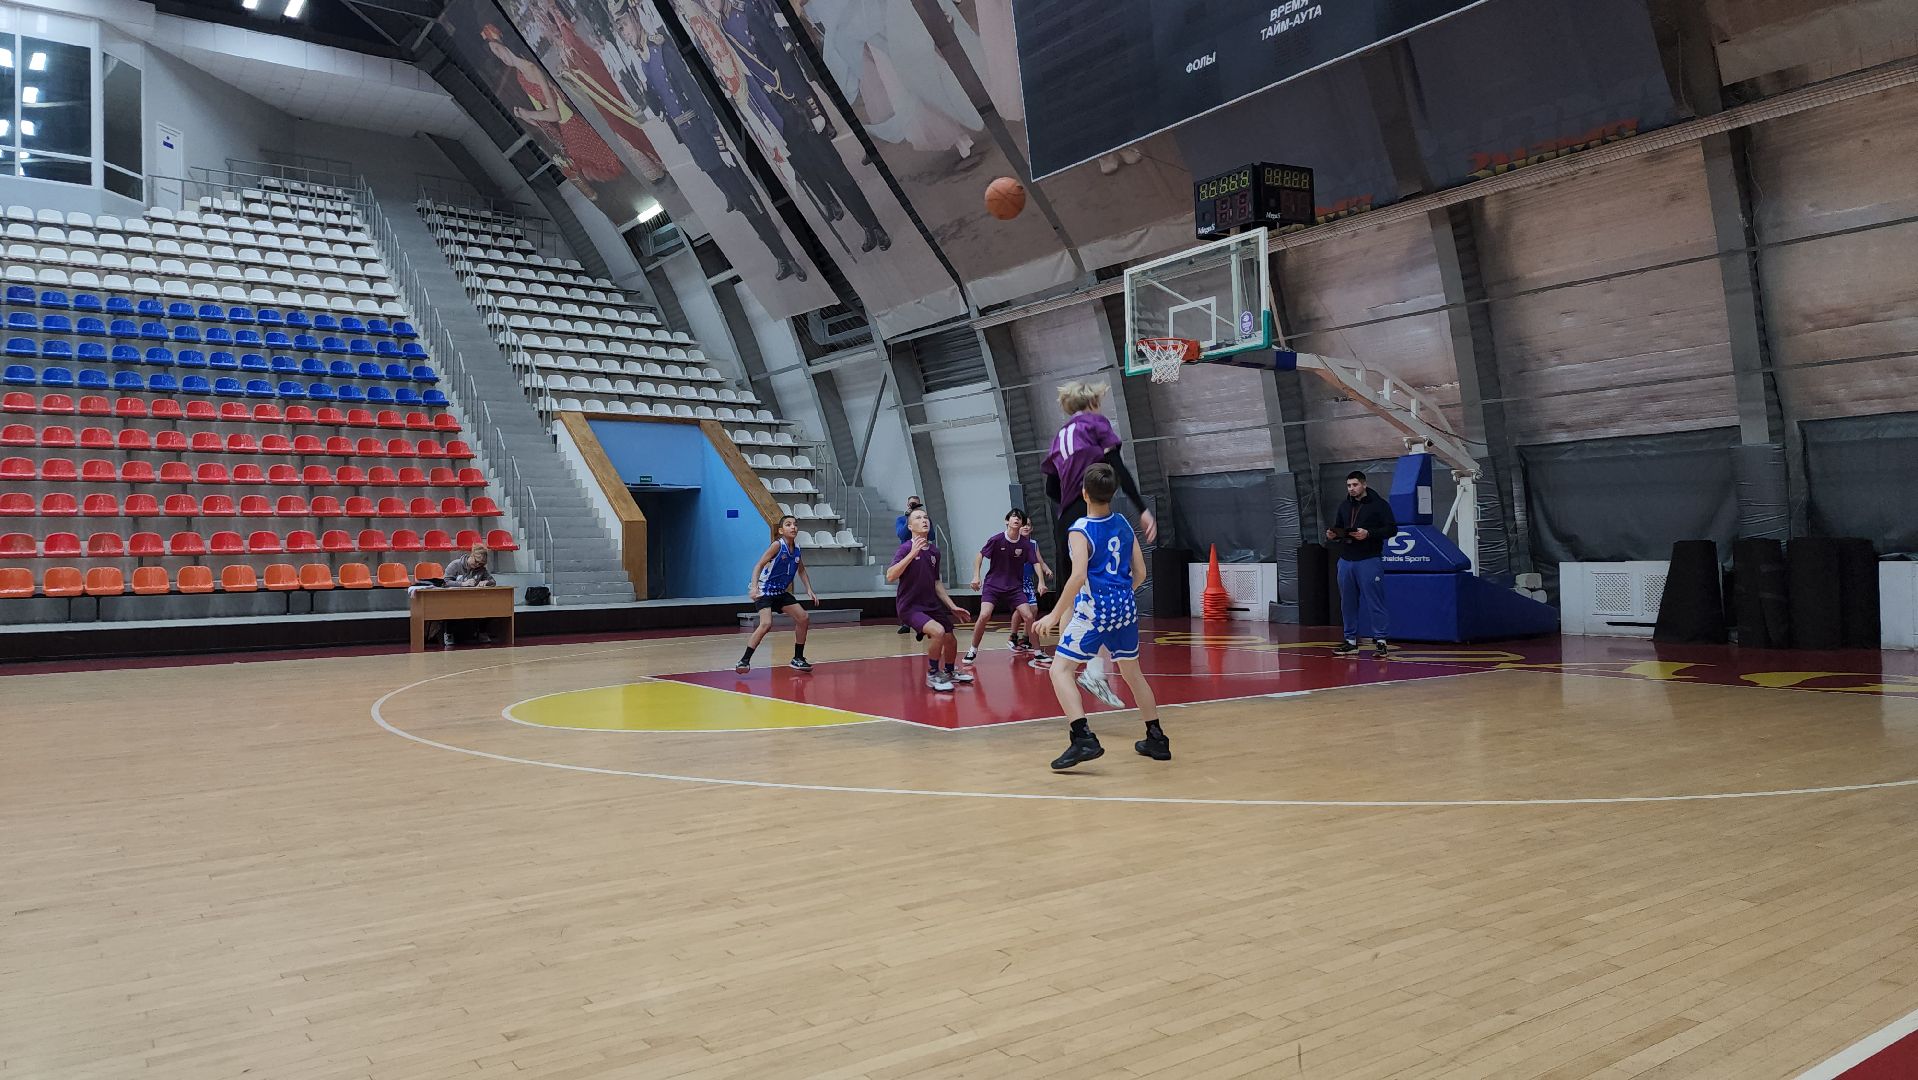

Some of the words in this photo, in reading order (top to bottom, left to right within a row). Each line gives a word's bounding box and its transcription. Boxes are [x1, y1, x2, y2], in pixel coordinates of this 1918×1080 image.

[1260, 4, 1323, 41] ТАЙМ-АУТА
[1185, 51, 1217, 74] ФОЛЫ
[1058, 422, 1077, 461] 11
[1105, 535, 1121, 575] 3
